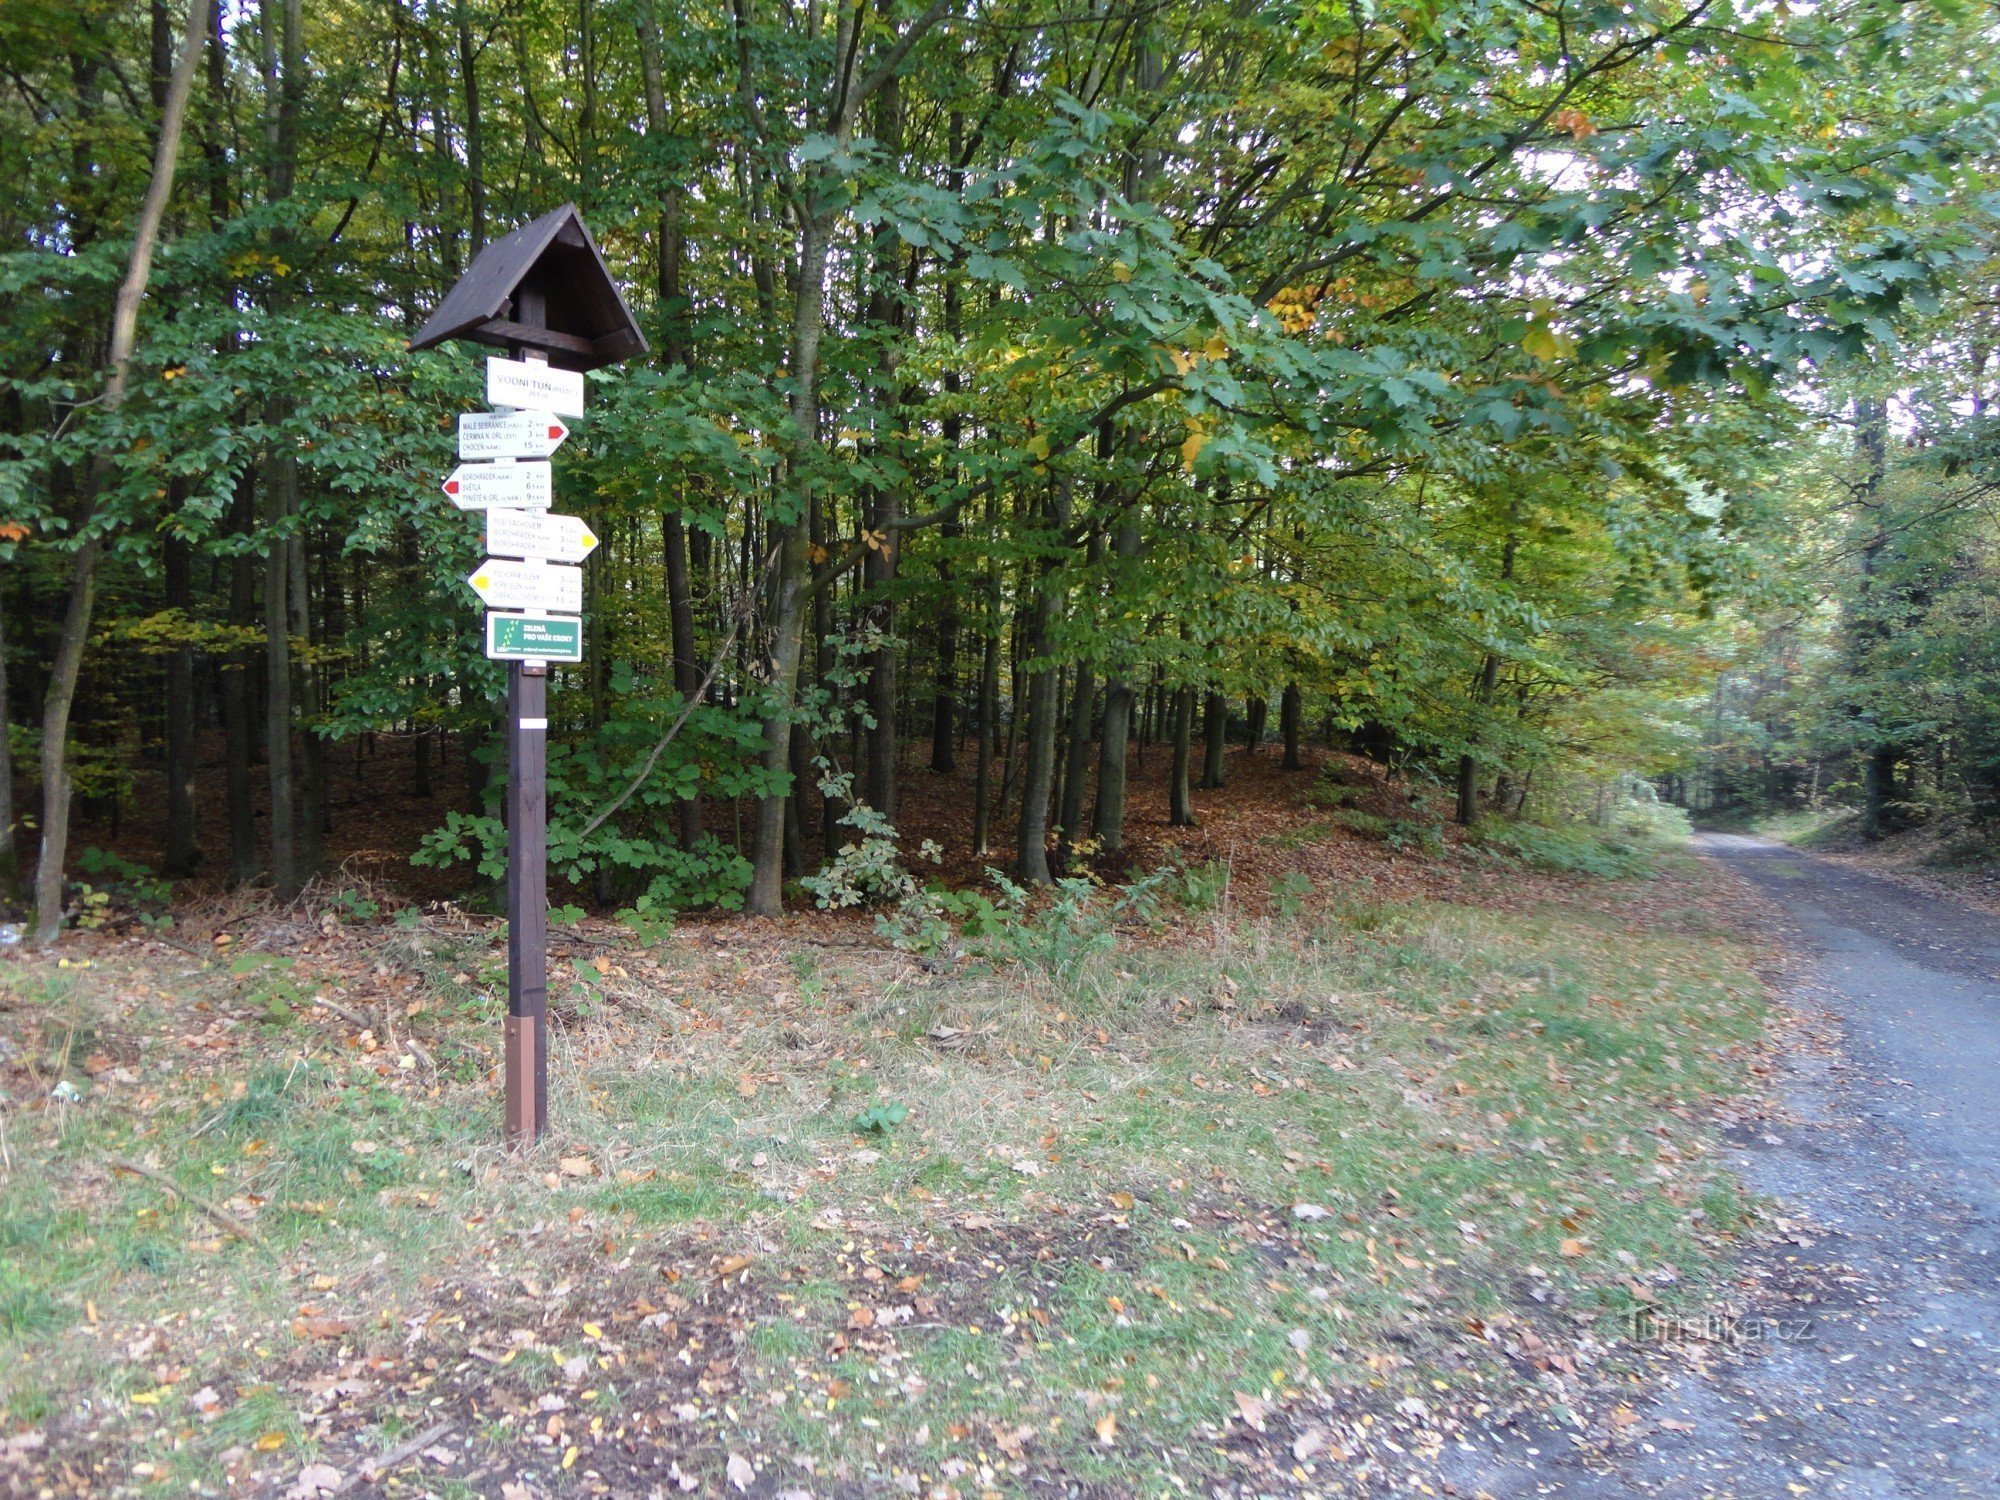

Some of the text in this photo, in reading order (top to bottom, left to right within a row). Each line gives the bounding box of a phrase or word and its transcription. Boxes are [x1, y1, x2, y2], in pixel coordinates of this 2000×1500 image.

[528, 420, 533, 428] 2
[524, 441, 533, 449] 15
[523, 633, 573, 643] PRO VAŠE KROKY
